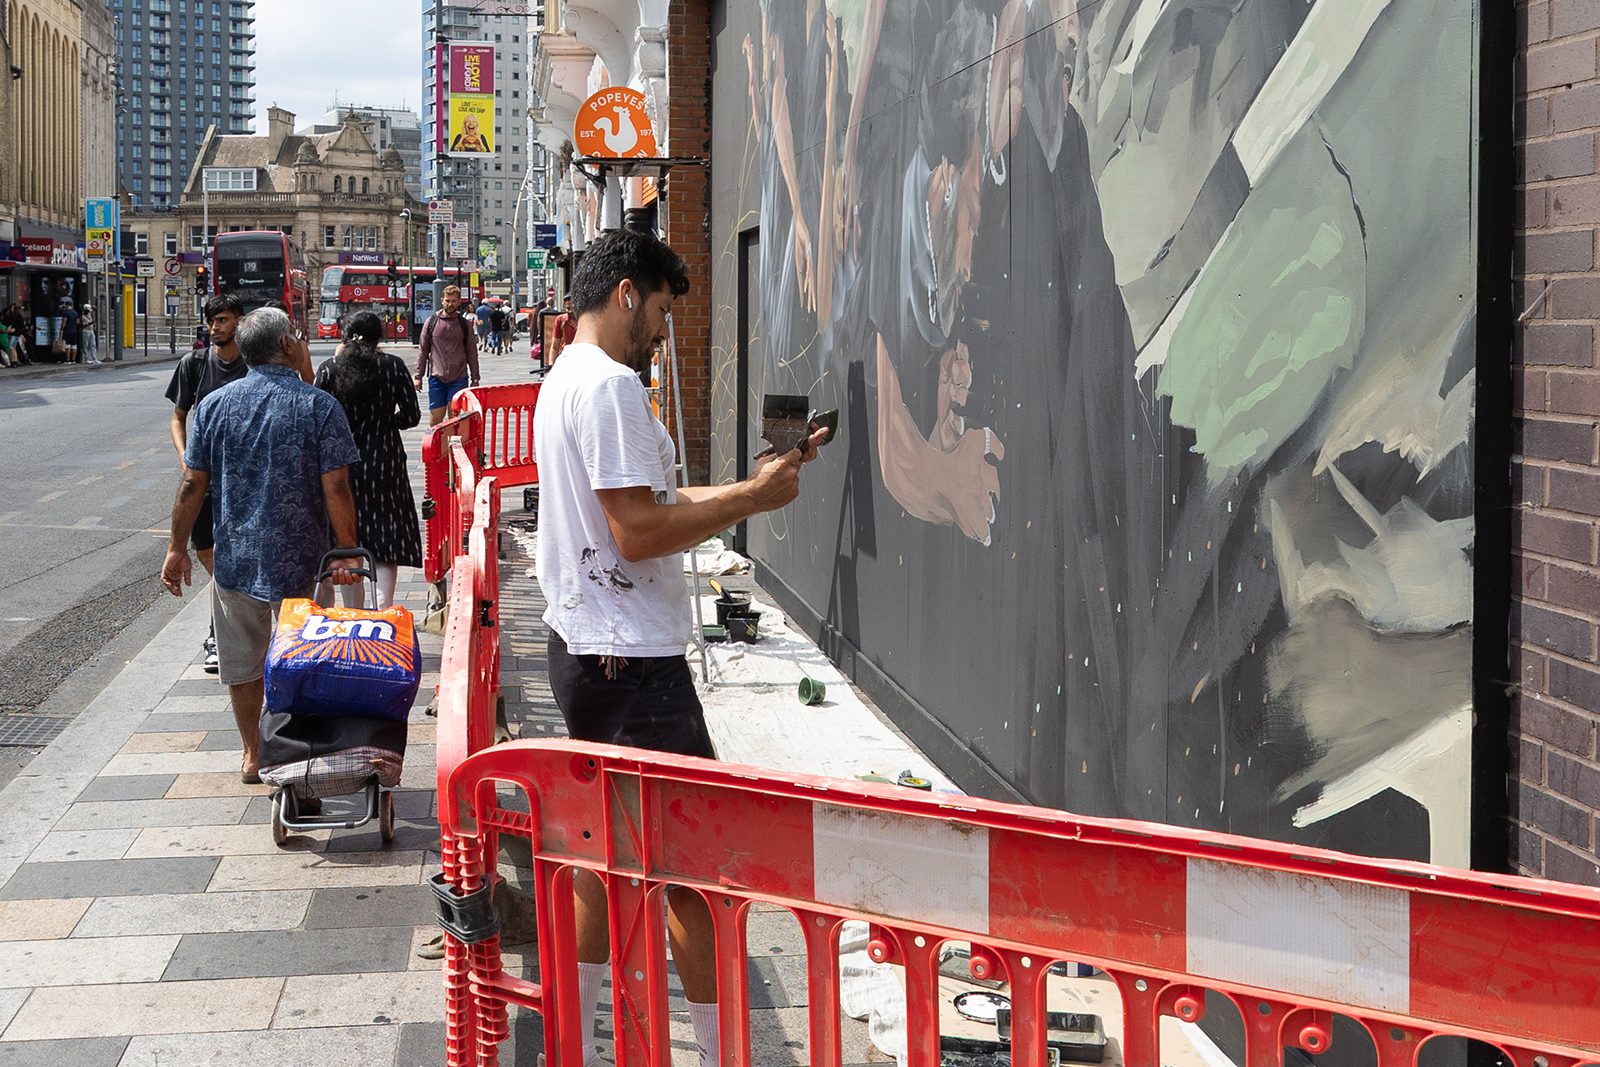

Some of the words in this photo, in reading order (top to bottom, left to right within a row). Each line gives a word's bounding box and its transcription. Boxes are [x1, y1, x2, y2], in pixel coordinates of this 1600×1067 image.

[471, 62, 480, 87] LOVE
[590, 92, 644, 112] POPEYES
[580, 130, 596, 138] EST.
[352, 254, 379, 262] NatWest
[244, 262, 257, 272] 179
